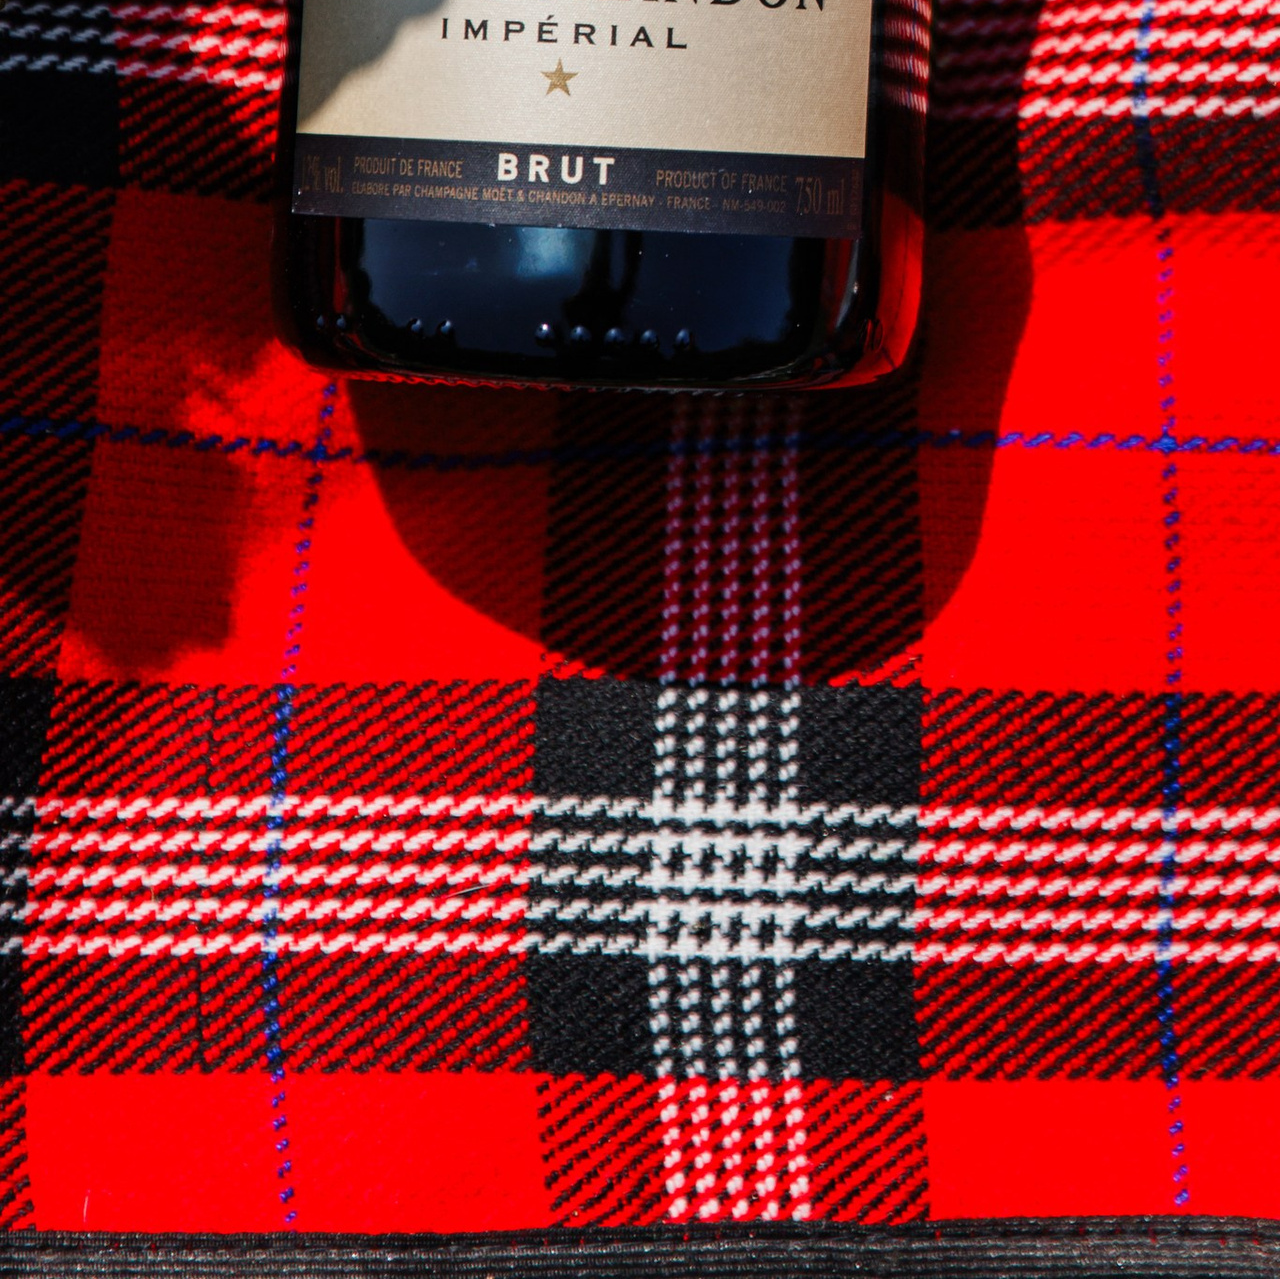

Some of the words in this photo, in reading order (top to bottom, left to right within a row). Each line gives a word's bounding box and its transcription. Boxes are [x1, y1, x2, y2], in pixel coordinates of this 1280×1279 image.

[441, 14, 688, 50] IMPÉRIAL
[353, 156, 396, 175] PRODUIT
[400, 159, 414, 177] DE
[417, 159, 464, 179] FRANCE
[497, 152, 616, 185] BRUT
[656, 169, 718, 189] PRODUCT
[721, 173, 737, 189] OF
[741, 175, 788, 192] FRANCE
[393, 183, 411, 197] PAR
[414, 185, 479, 201] CHAMPAGNE
[528, 190, 586, 205] CHANDON
[666, 196, 711, 211] FRANCE
